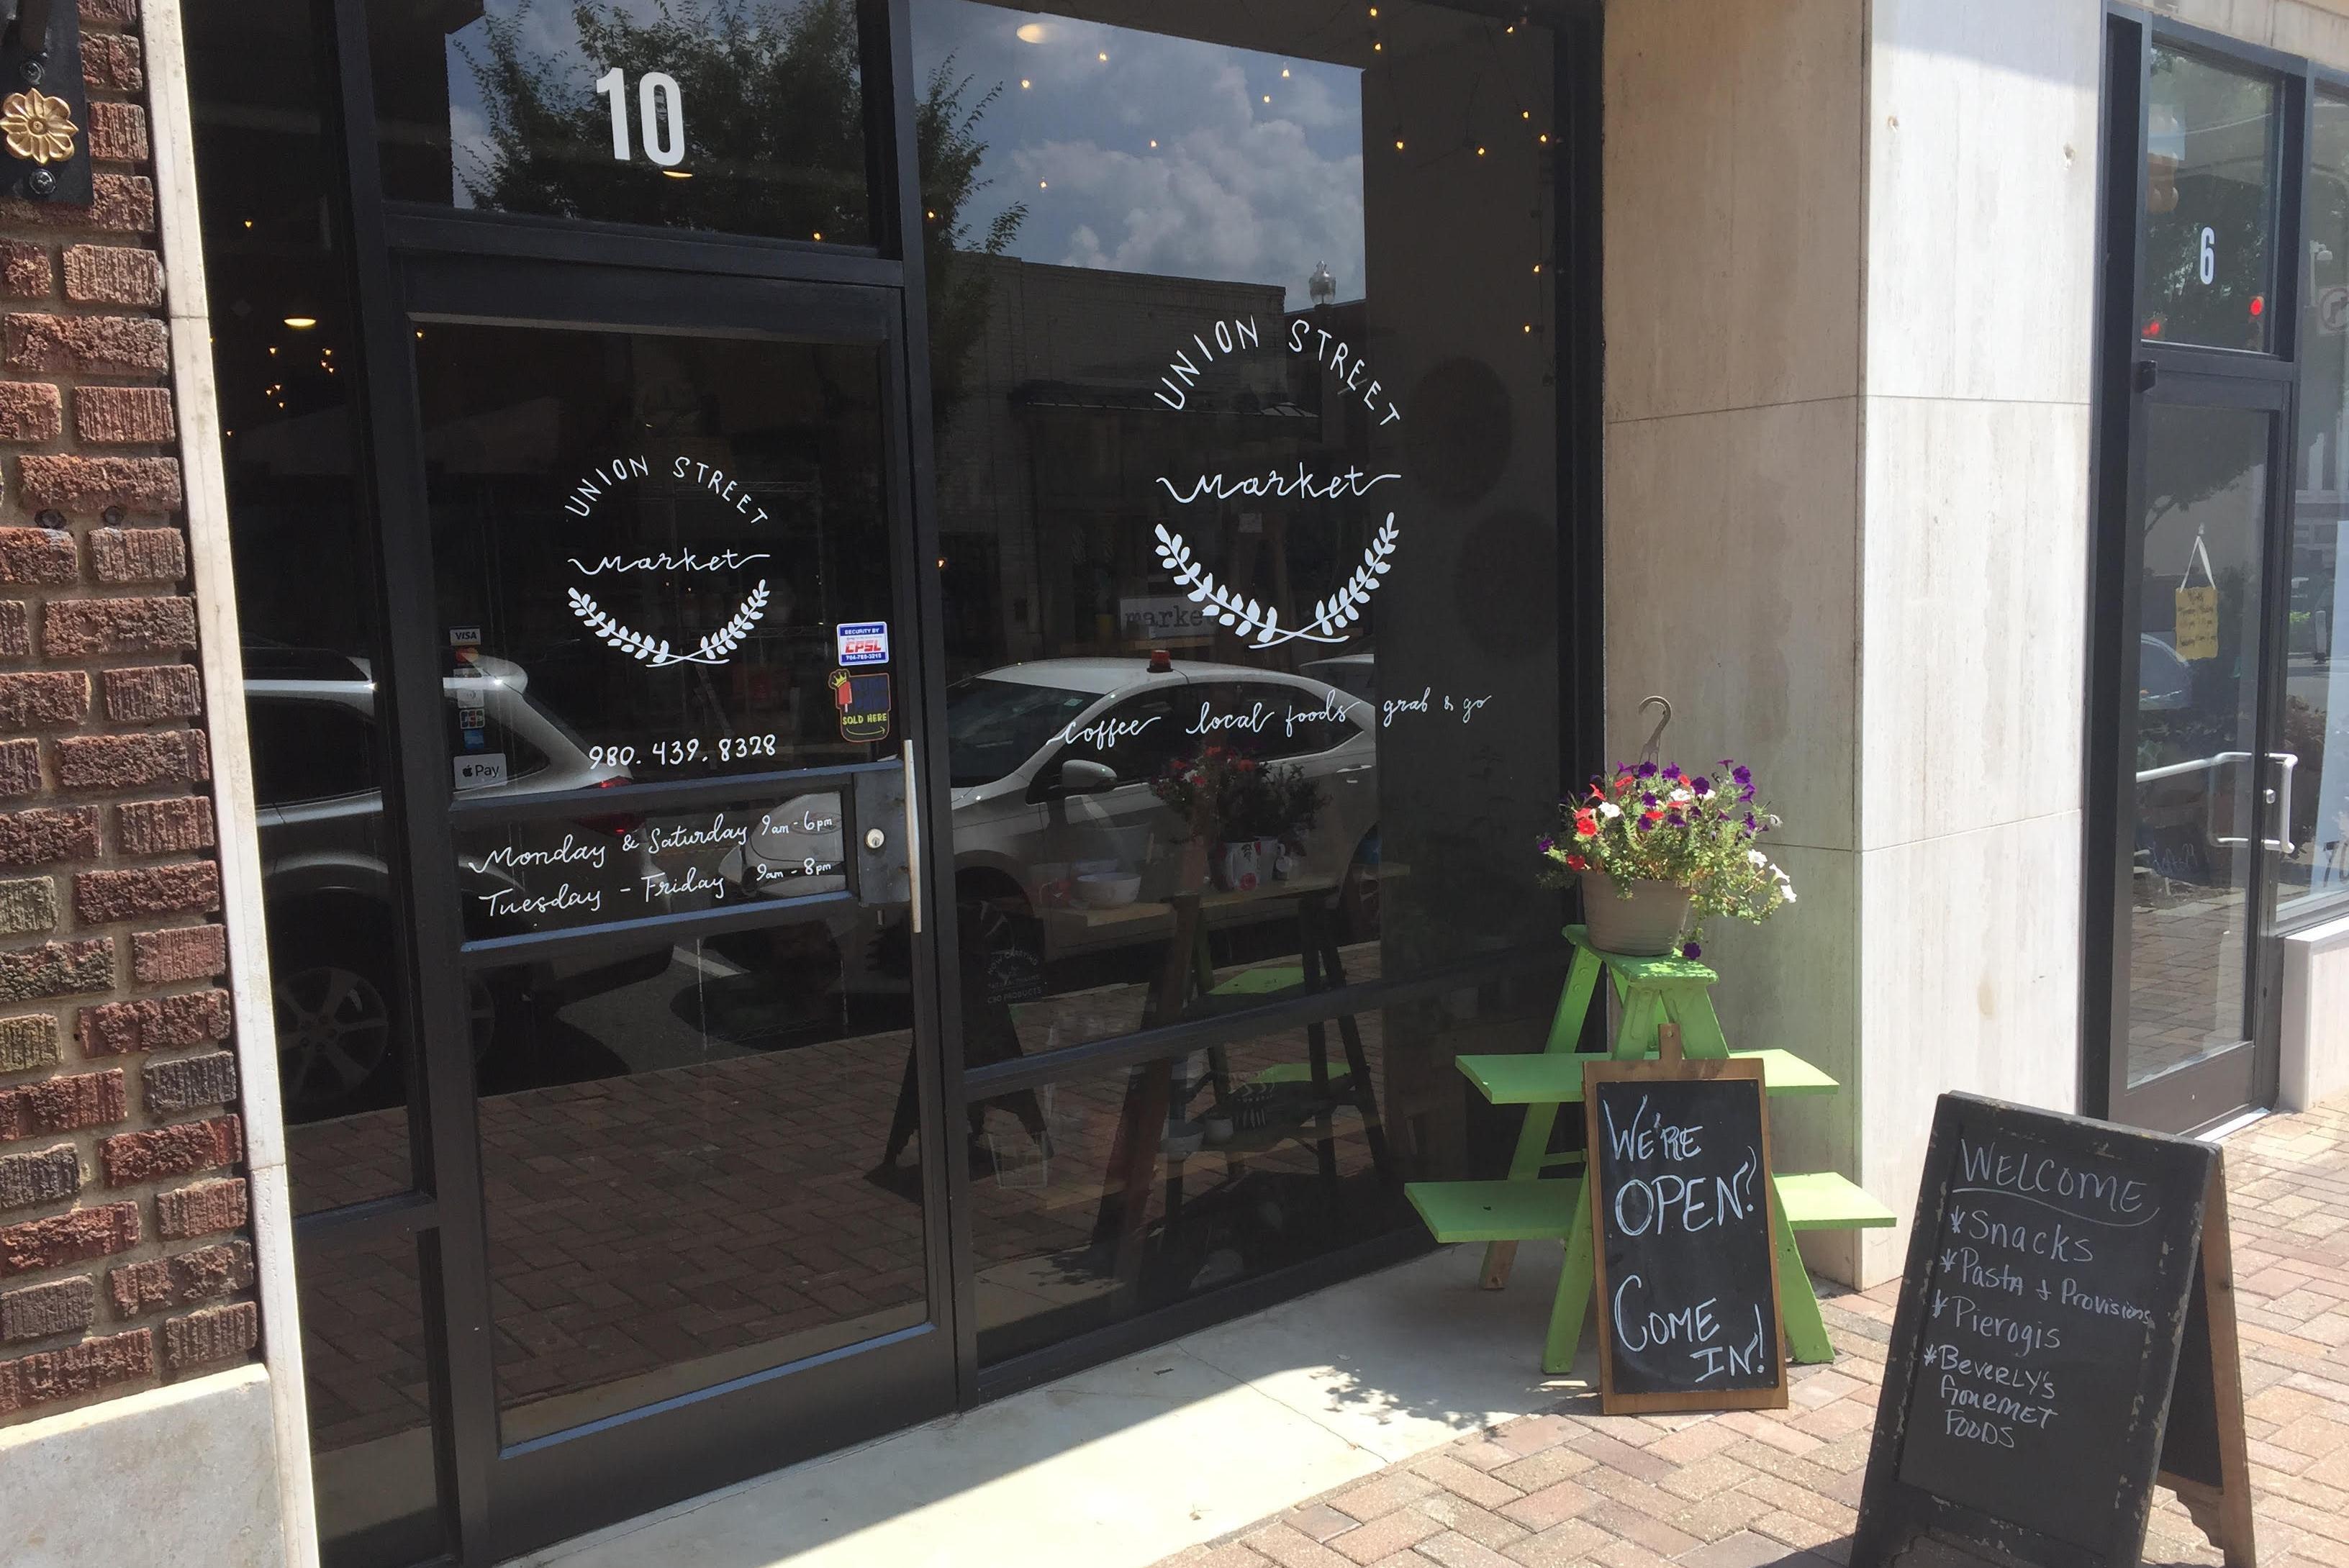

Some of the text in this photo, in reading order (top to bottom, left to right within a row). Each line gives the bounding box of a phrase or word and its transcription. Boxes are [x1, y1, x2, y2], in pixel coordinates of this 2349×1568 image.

[596, 68, 685, 166] 10
[2199, 227, 2215, 284] 6
[1154, 315, 1400, 425] UNION STREET
[564, 455, 768, 523] UNION STREET
[1156, 462, 1401, 503] market
[568, 548, 770, 575] market
[456, 631, 476, 640] VISA
[845, 639, 882, 653] CPSL
[842, 712, 887, 725] SOLD HERE
[1046, 690, 1359, 750] coffee local foods
[1383, 687, 1491, 728] grab & go
[475, 764, 499, 779] Pay
[589, 734, 775, 767] 980. 439. 8328
[468, 834, 605, 873] Monday
[623, 834, 639, 851] &
[648, 813, 747, 853] Saturday
[479, 883, 601, 917] Tuesday
[641, 866, 724, 902] Friday
[1615, 1146, 1757, 1236] OPEN!
[1960, 1138, 2147, 1213] WELCOME
[1969, 1209, 2094, 1262] Snacks
[1613, 1275, 1721, 1353] COME
[1950, 1295, 2061, 1358] Pierogis
[2061, 1278, 2152, 1325] Provisions
[1689, 1303, 1765, 1382] IN!
